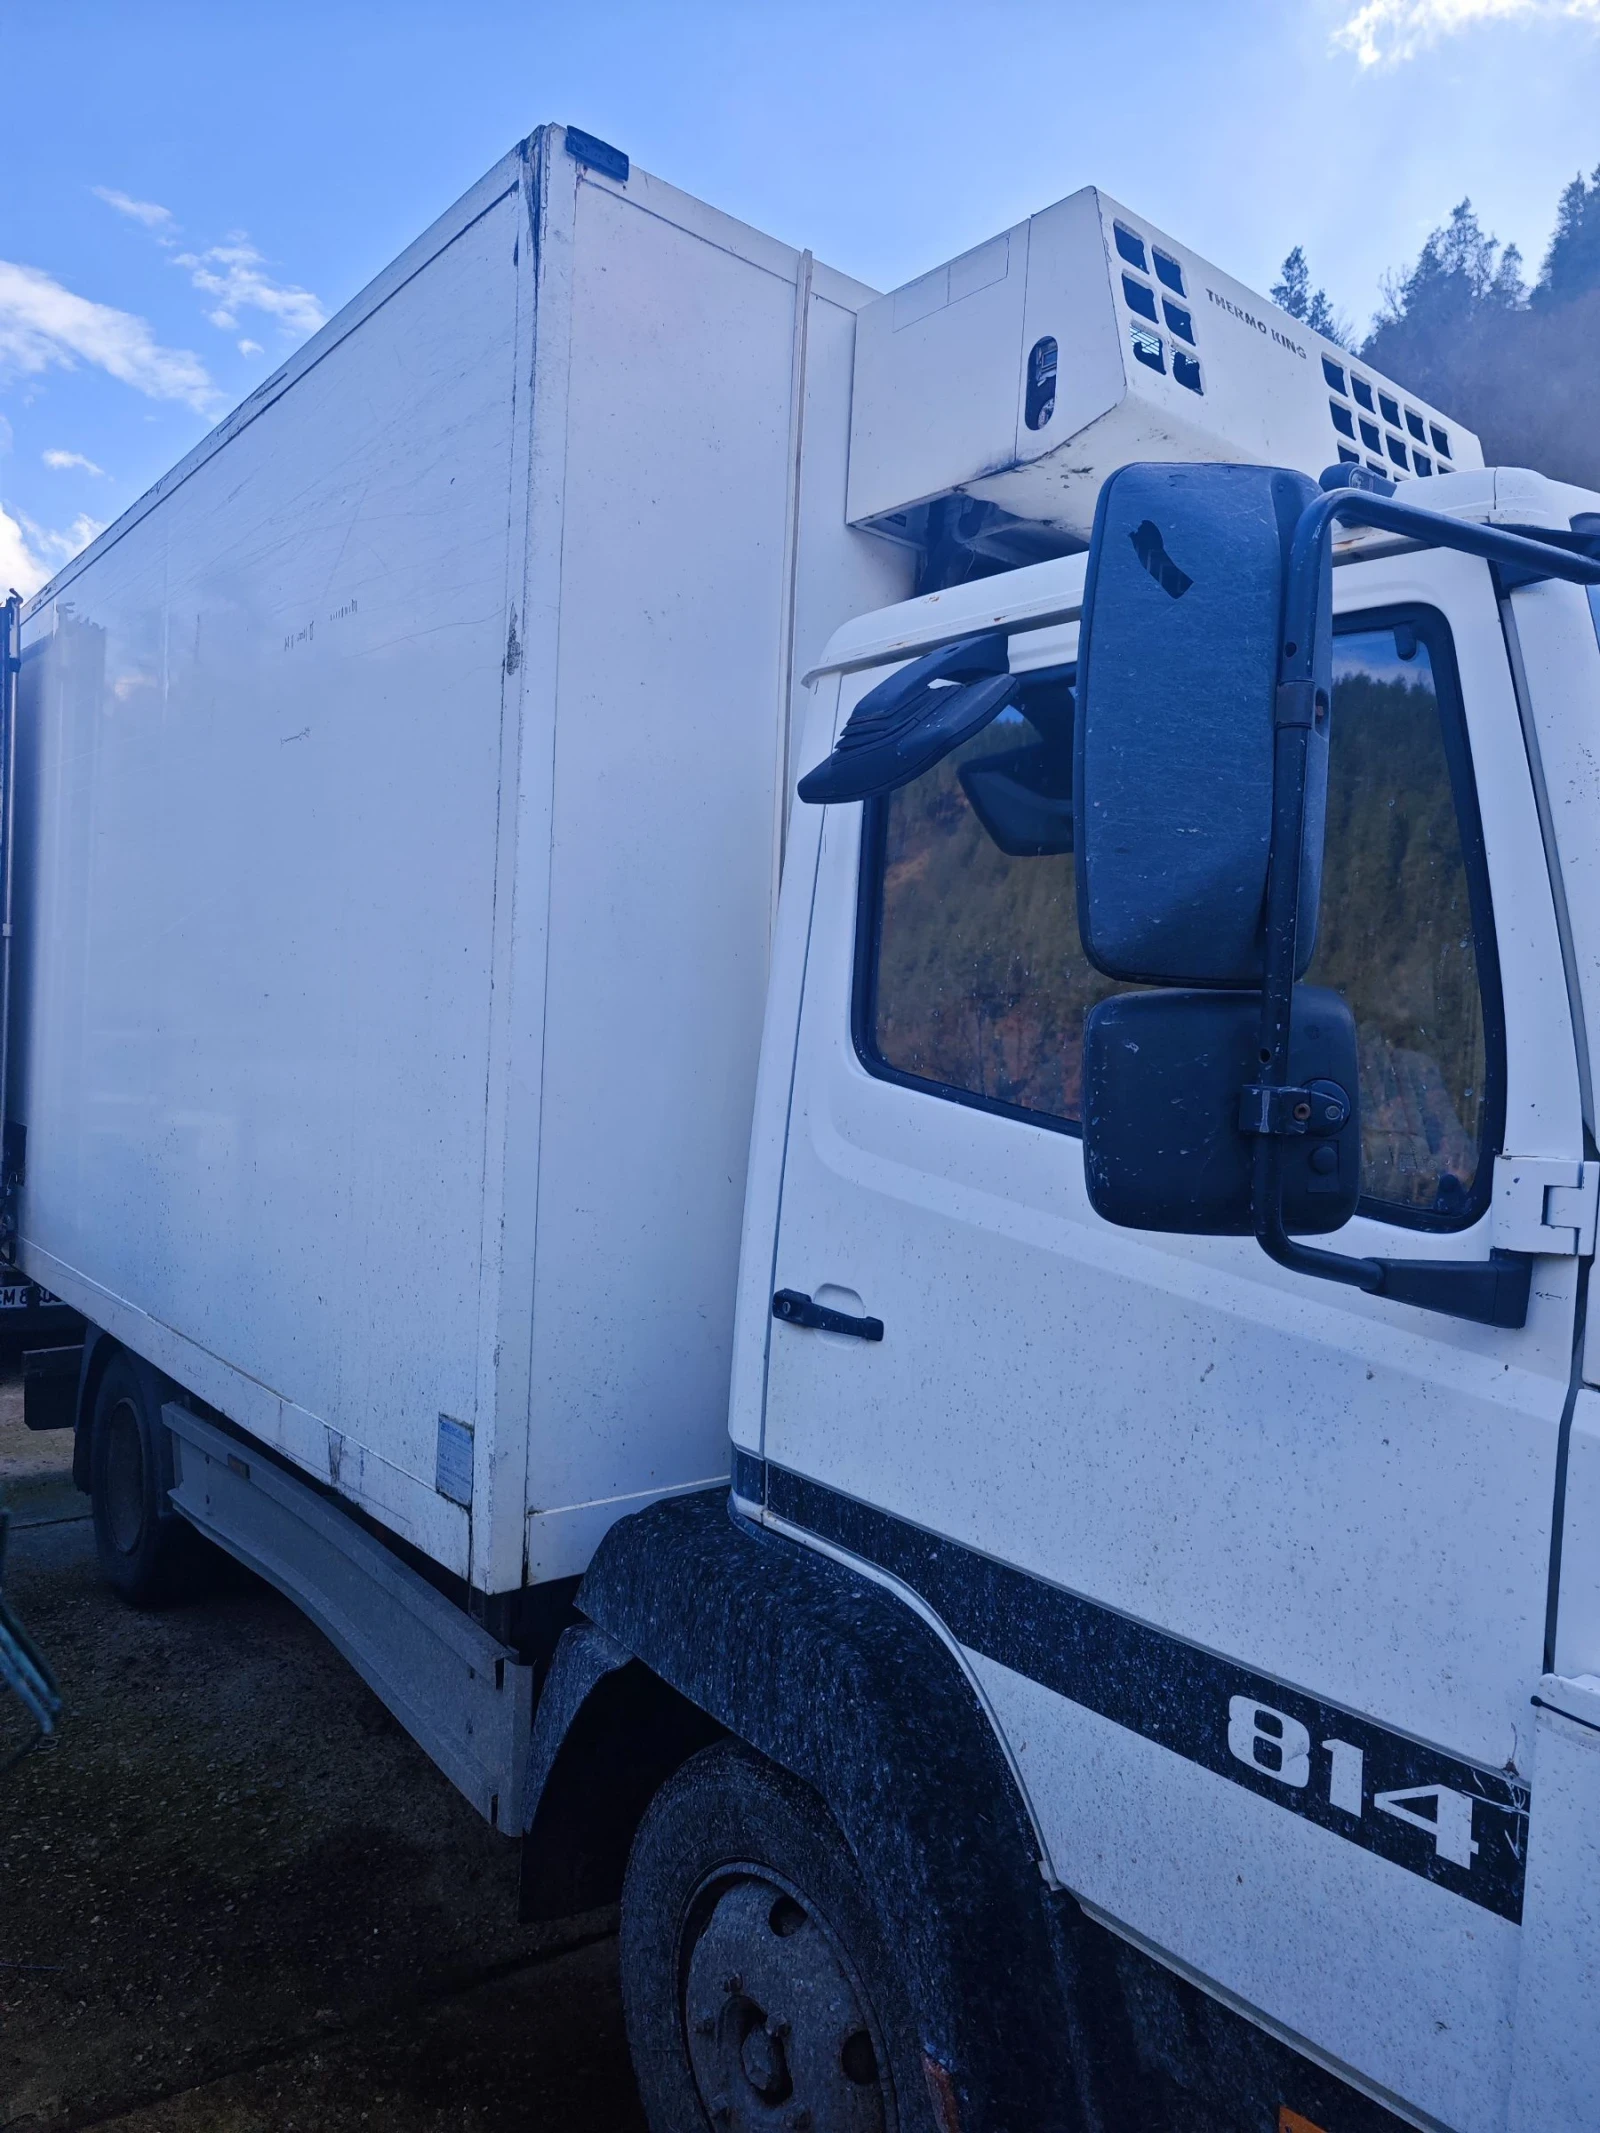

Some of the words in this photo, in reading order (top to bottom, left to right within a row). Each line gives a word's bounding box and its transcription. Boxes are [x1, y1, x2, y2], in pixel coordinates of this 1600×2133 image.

[1205, 287, 1267, 335] THERMO
[1270, 328, 1307, 360] KING
[1228, 1695, 1479, 1870] 814
